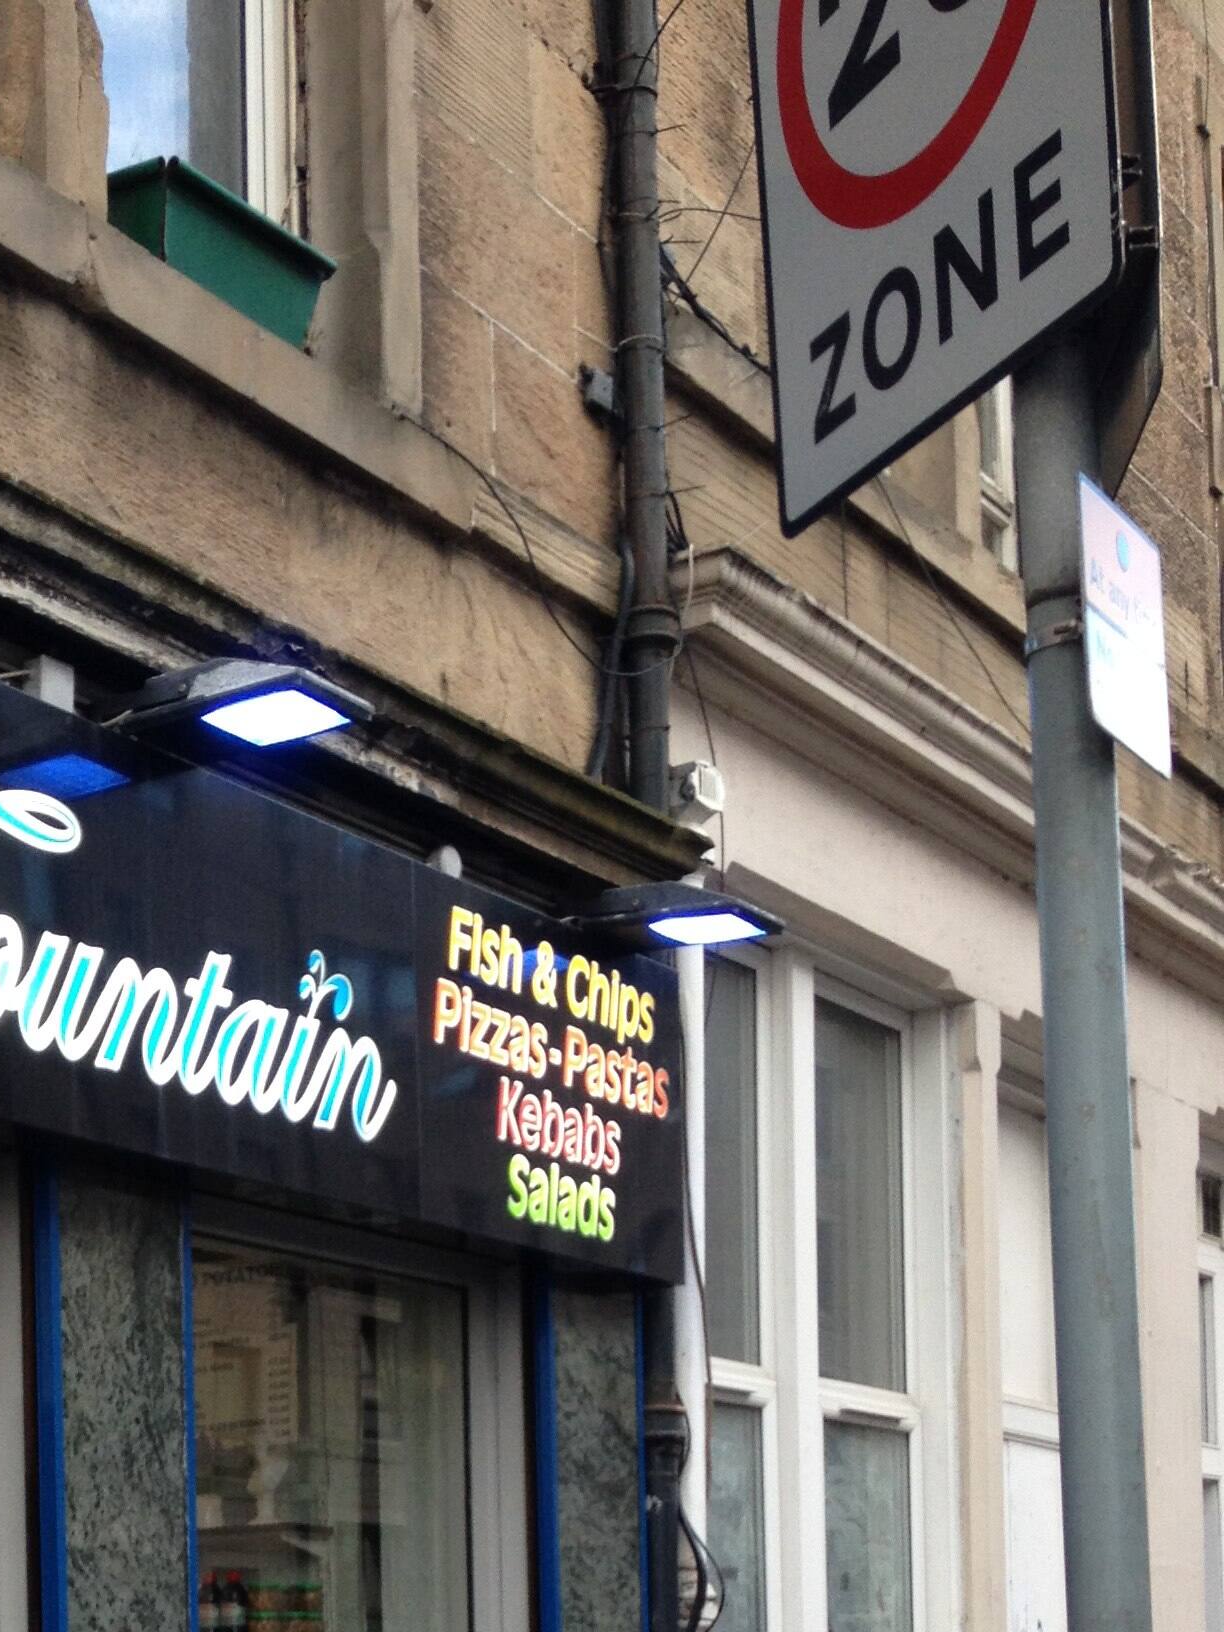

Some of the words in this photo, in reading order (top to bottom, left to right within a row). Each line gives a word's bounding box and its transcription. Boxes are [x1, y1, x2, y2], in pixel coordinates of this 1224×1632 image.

[818, 0, 970, 131] 2
[810, 128, 1071, 445] ZONE
[448, 905, 524, 994] Fish
[531, 940, 559, 1009] &
[566, 954, 656, 1045] Chips
[495, 1076, 622, 1176] Kebabs
[506, 1153, 617, 1243] Salads
